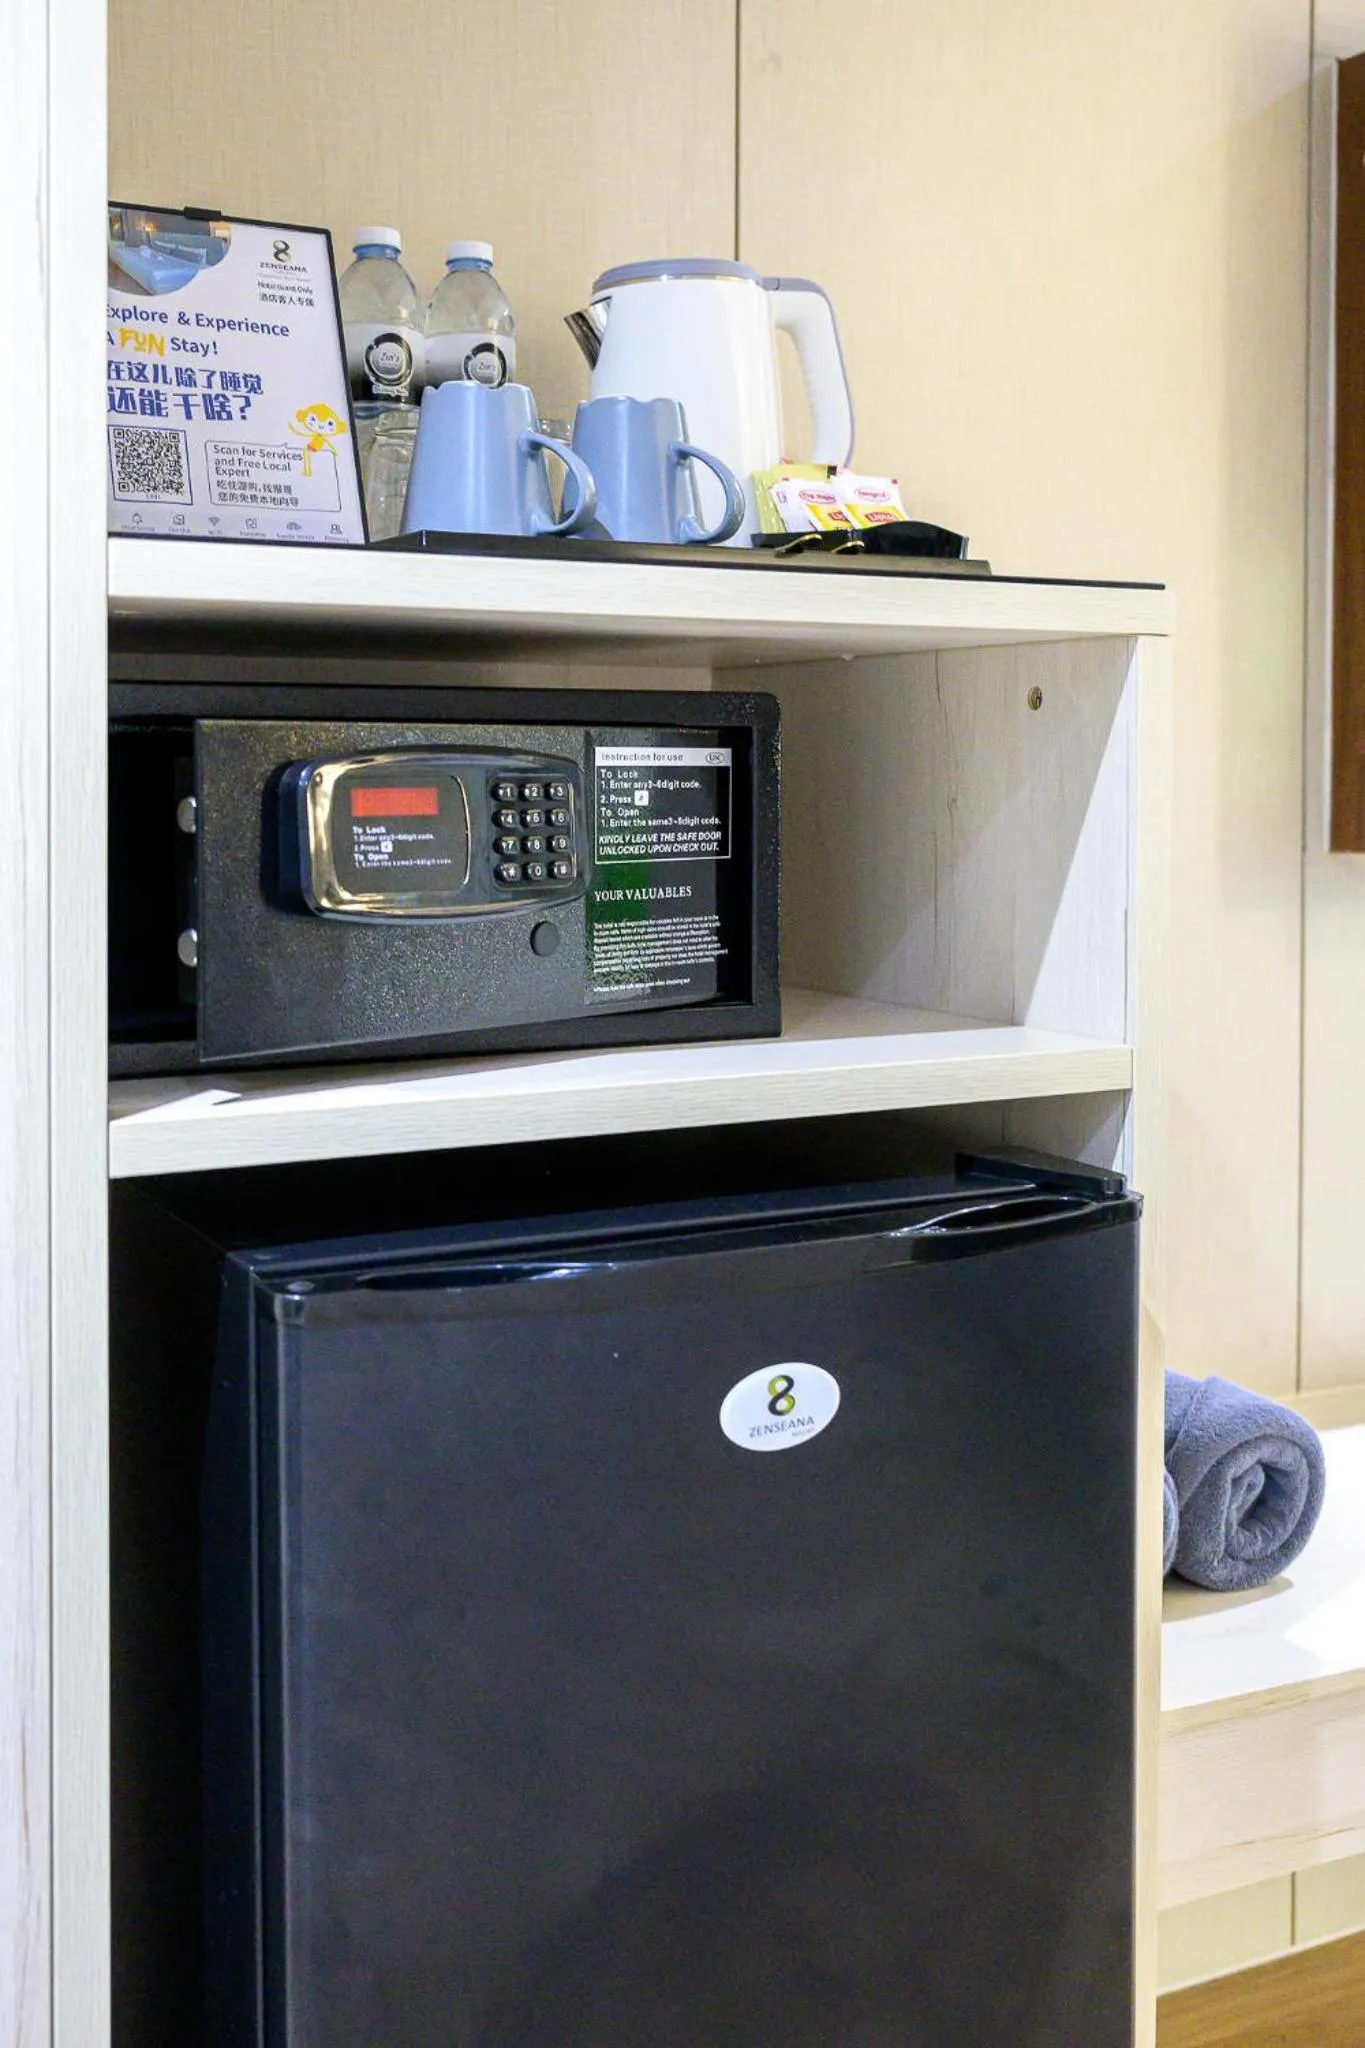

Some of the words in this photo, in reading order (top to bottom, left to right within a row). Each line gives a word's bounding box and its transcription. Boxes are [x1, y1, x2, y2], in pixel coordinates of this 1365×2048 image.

[177, 311, 191, 326] &
[195, 312, 291, 338] Experience
[118, 327, 166, 358] FUN
[170, 336, 219, 358] Stay!
[107, 359, 265, 396] 在这儿除了睡觉
[213, 444, 239, 456] Scan
[242, 445, 257, 457] for
[259, 448, 304, 461] Services
[214, 457, 235, 467] and
[238, 458, 260, 469] Free
[262, 461, 292, 472] Local
[214, 467, 250, 478] Expert
[601, 752, 650, 761] Instruction
[653, 752, 666, 761] for
[600, 768, 613, 779] To
[617, 769, 638, 779] Lock
[600, 807, 613, 817] To
[617, 807, 640, 820] Open
[633, 818, 646, 827] the
[631, 833, 658, 844] LEAVE
[660, 832, 676, 842] THE
[677, 831, 697, 842] SAFE
[698, 831, 722, 841] DOOR
[600, 845, 646, 856] UNLOCKED
[647, 843, 672, 854] UPON
[673, 842, 699, 853] CHECK
[700, 841, 720, 852] OUT.
[594, 889, 624, 902] YOUR
[627, 885, 692, 900] VALUABLES
[749, 1415, 815, 1438] ZENSEANA
